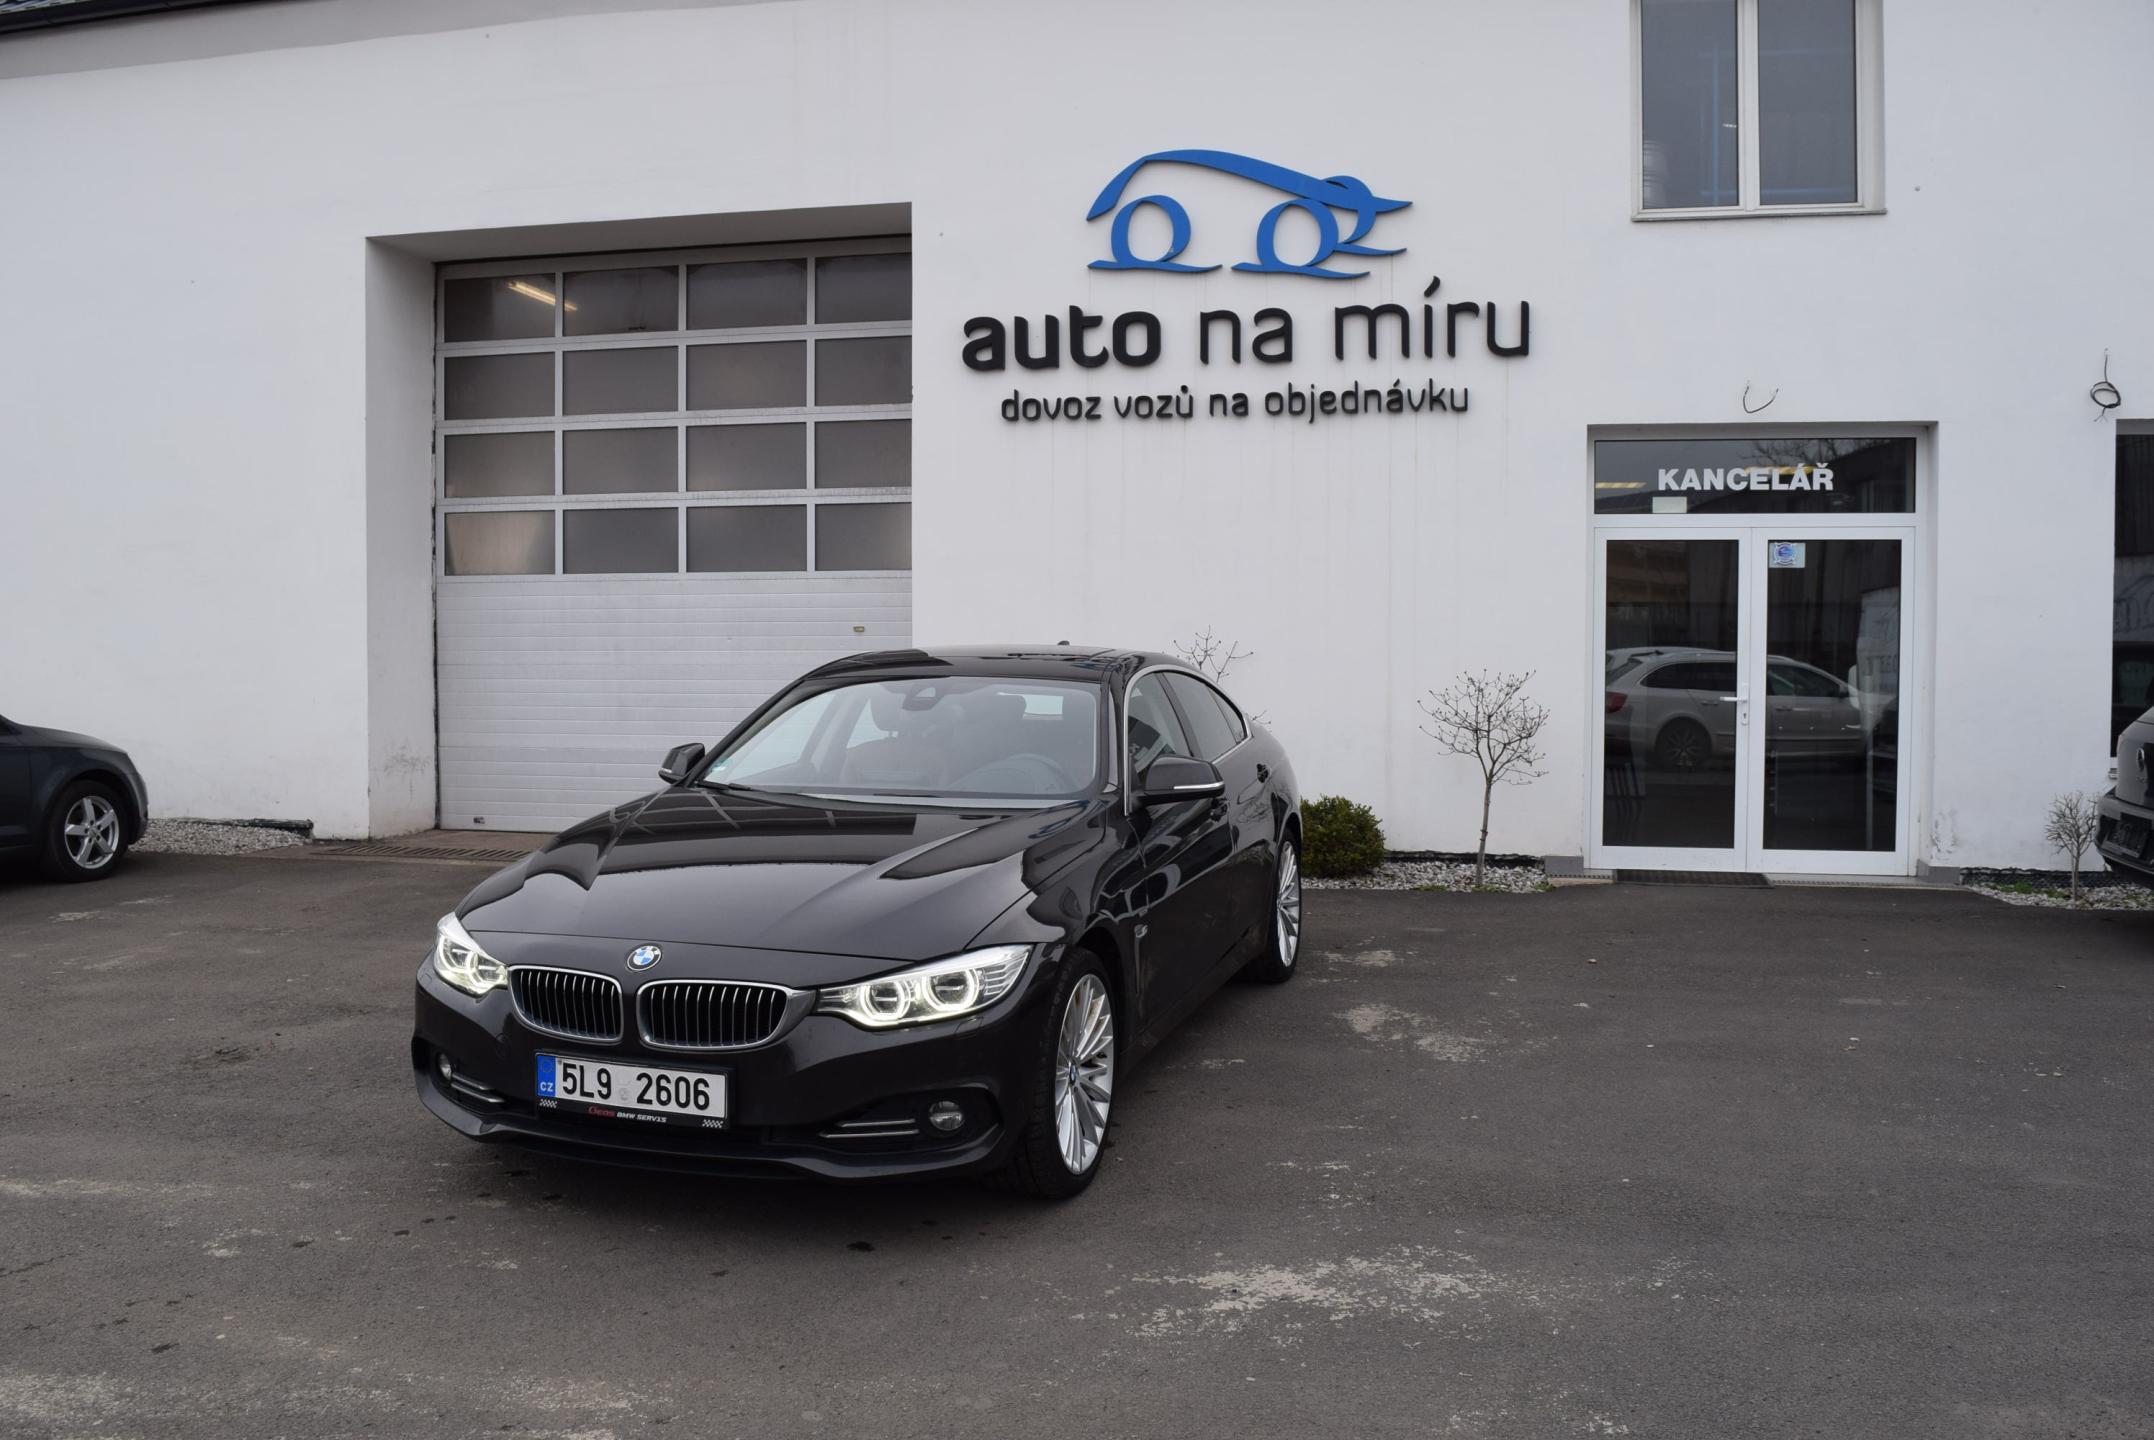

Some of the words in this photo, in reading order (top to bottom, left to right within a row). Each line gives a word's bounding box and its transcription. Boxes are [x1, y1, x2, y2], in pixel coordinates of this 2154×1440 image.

[962, 304, 1161, 372] auto
[1200, 307, 1293, 365] na
[1335, 275, 1530, 360] míru
[1001, 388, 1102, 423] dovoz
[1114, 384, 1194, 422] vozů
[1209, 392, 1249, 418] na
[1264, 377, 1469, 425] objednávku
[1658, 462, 1834, 491] KANCELÁŘ
[540, 1081, 554, 1092] CZ
[562, 1062, 612, 1100] 5L9
[636, 1072, 710, 1111] 2606
